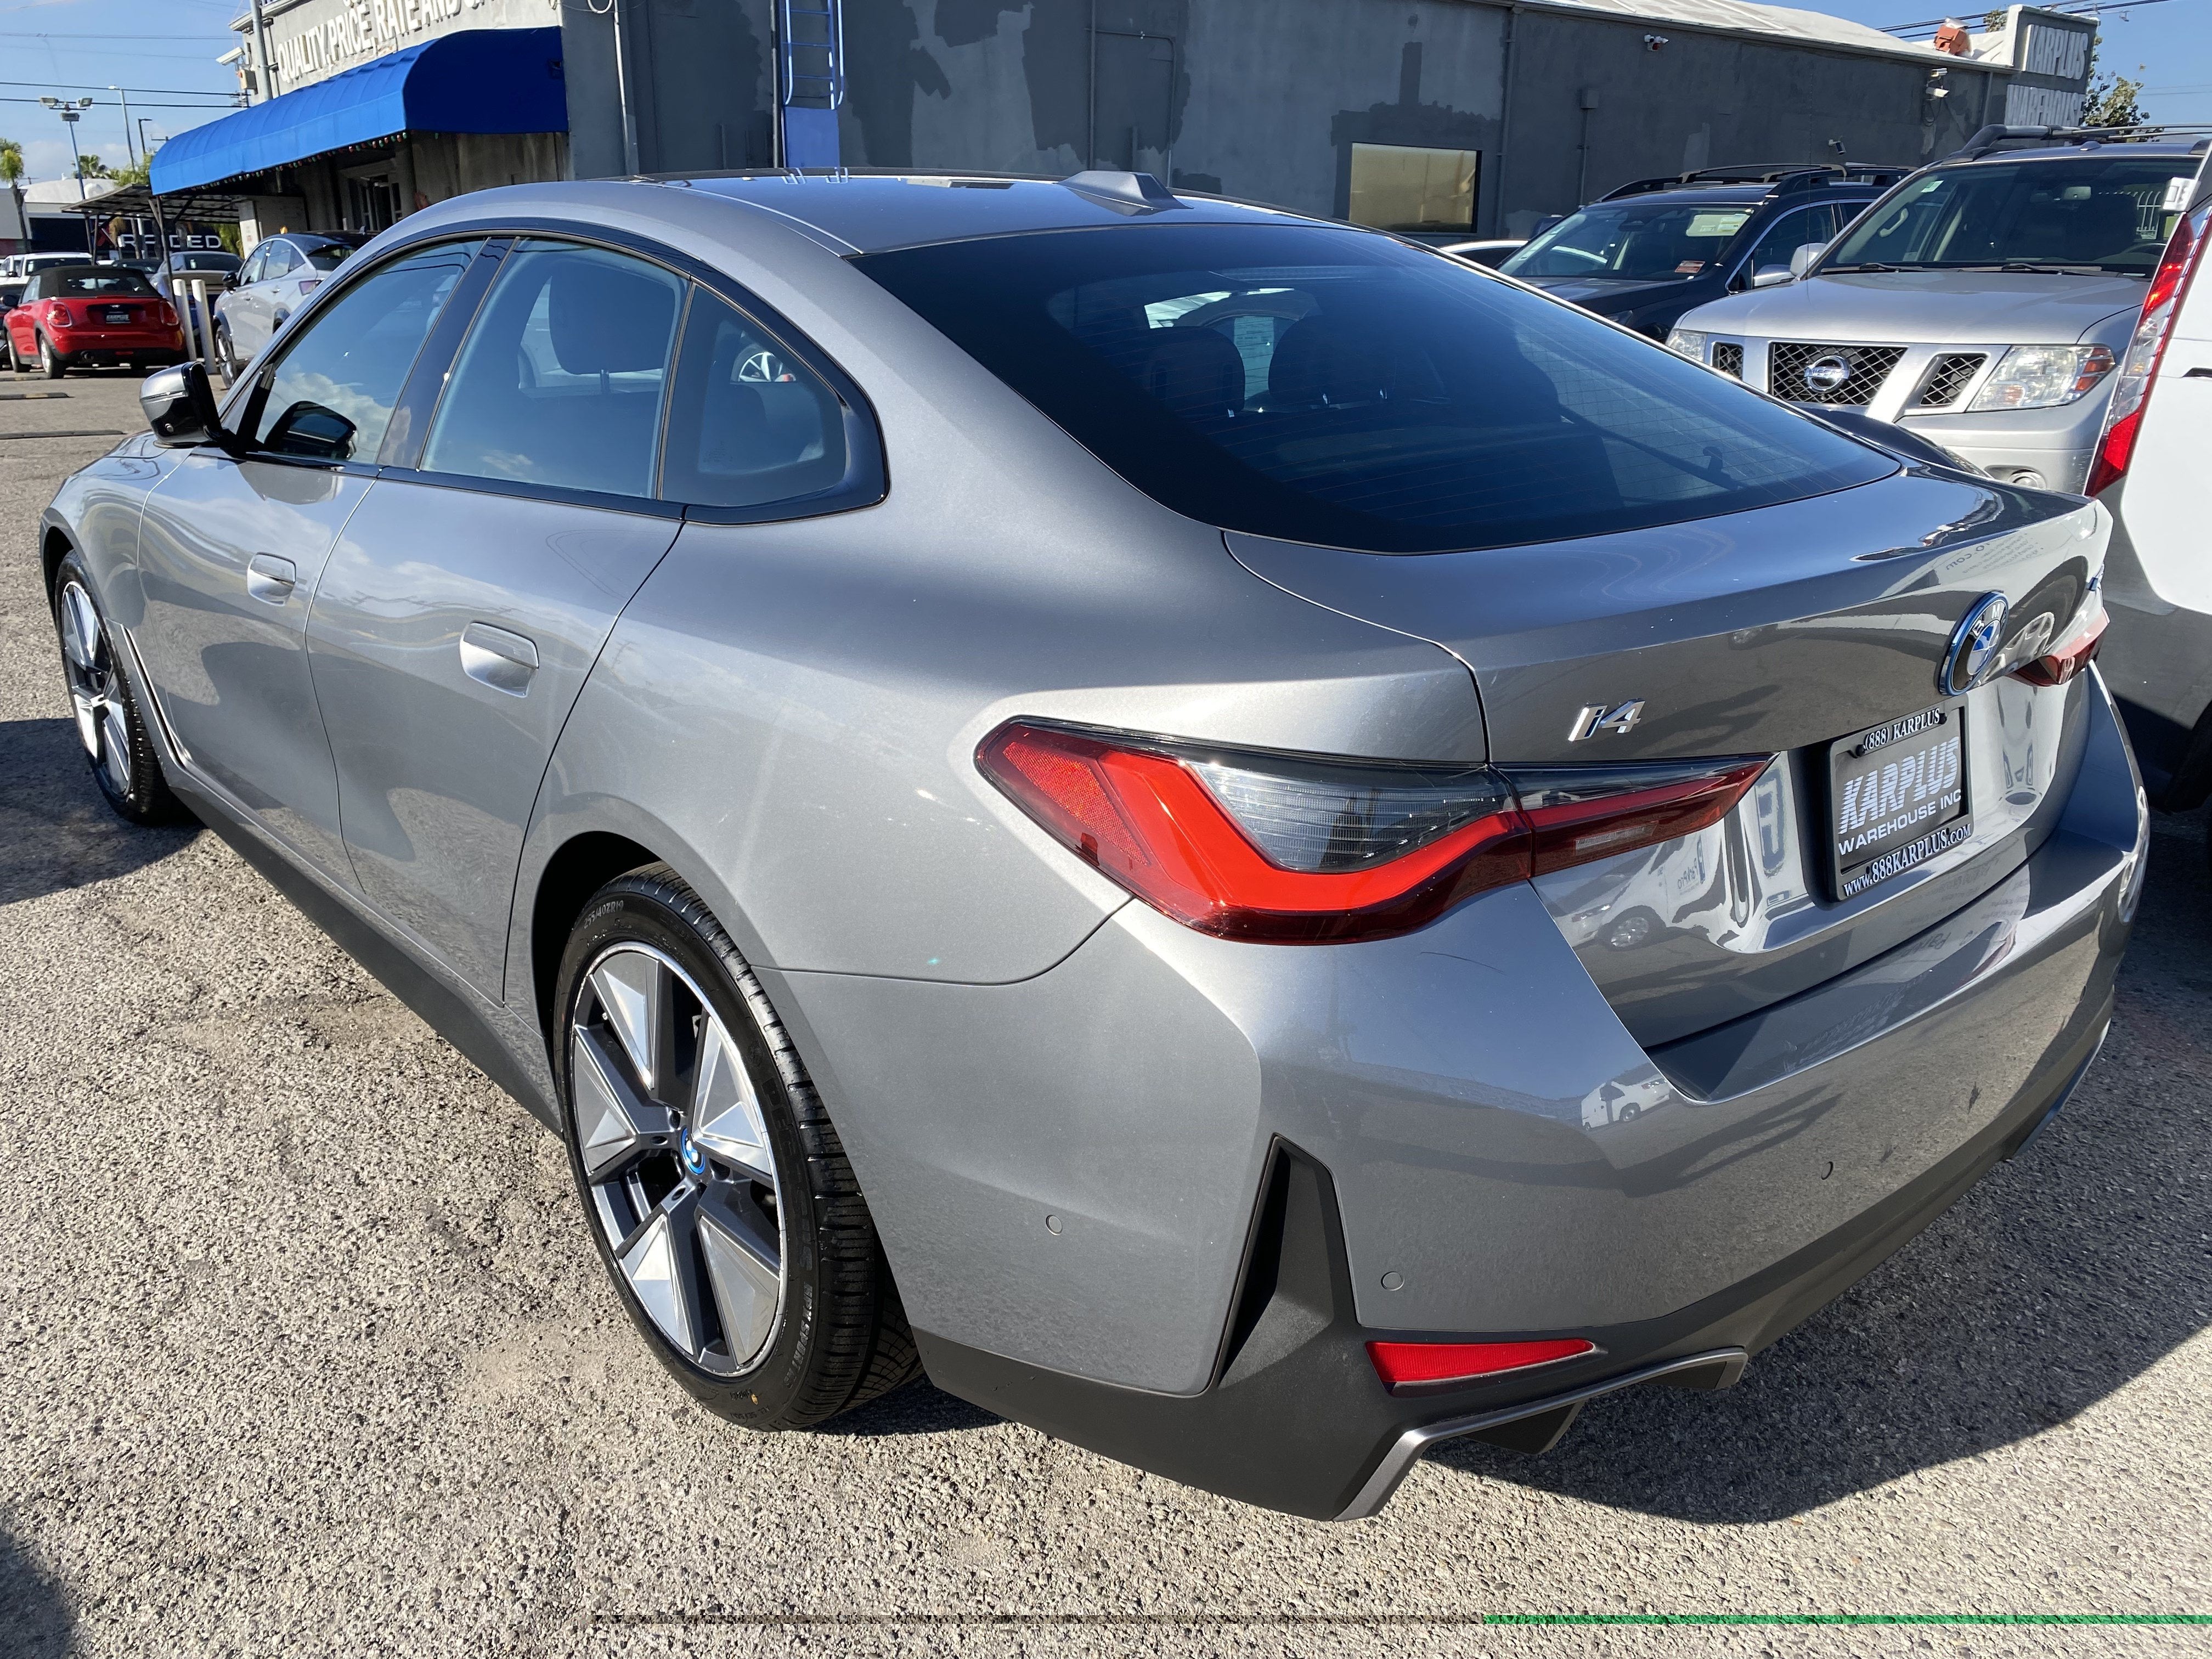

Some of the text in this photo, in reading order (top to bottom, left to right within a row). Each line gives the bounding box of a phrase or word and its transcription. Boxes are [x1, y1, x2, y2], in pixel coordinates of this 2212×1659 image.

[2023, 24, 2089, 80] KARPLUS
[2004, 84, 2085, 126] WAREHOUSE
[1568, 698, 1646, 742] i4
[1864, 708, 1940, 750] (888) KARPLUS
[1838, 736, 1959, 834] KARPLUS
[1838, 788, 1961, 855] WAREHOUSE INC
